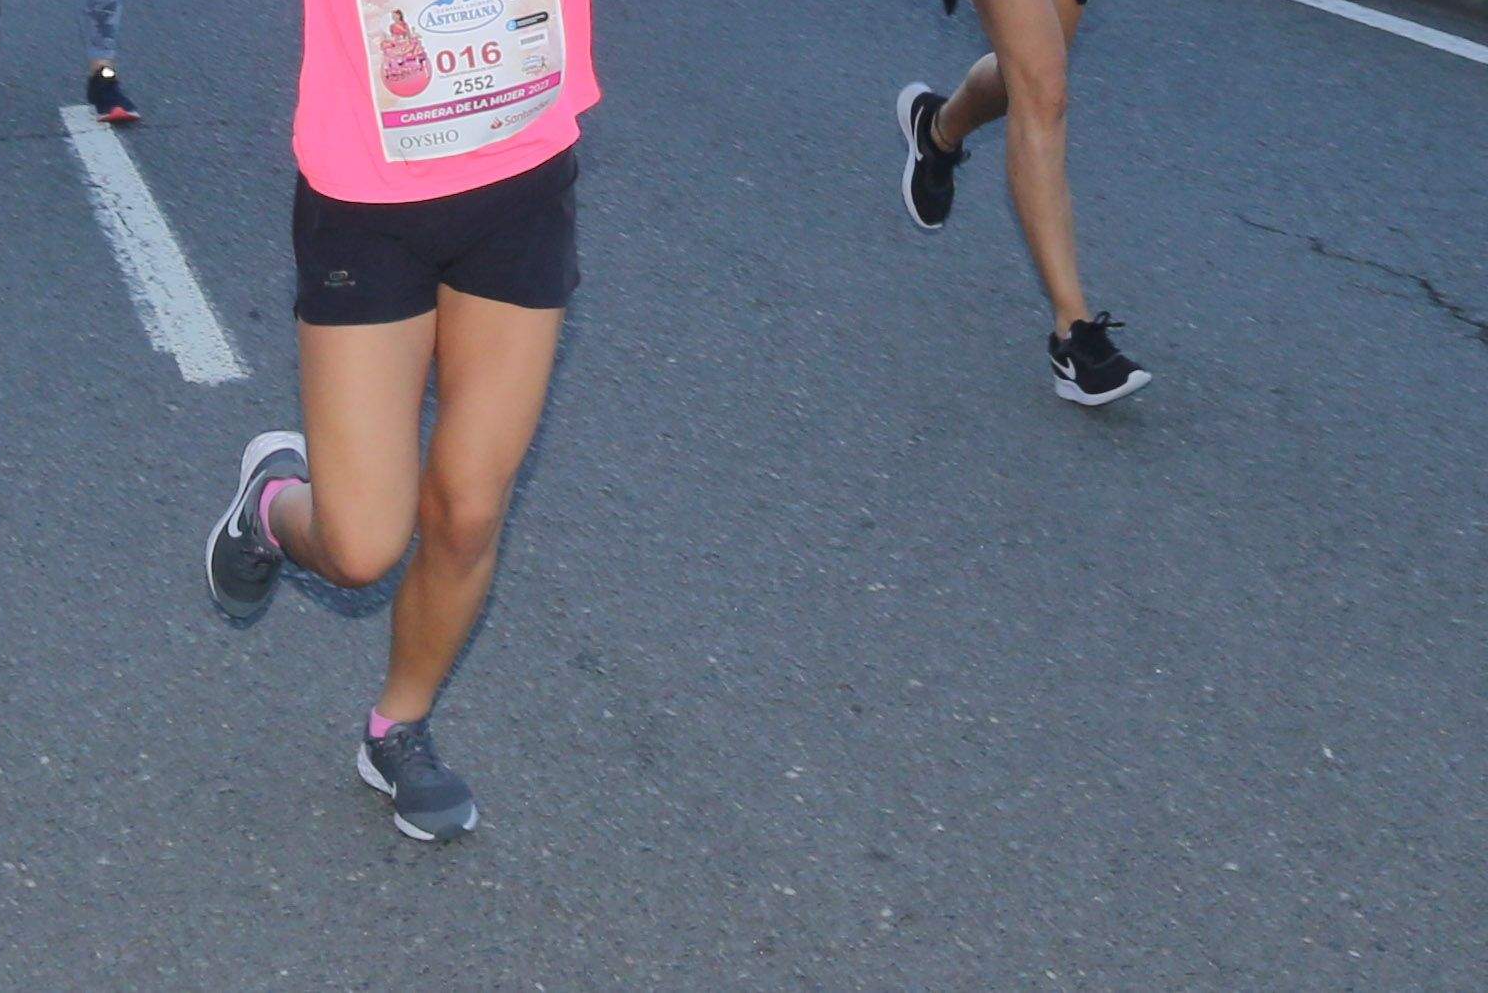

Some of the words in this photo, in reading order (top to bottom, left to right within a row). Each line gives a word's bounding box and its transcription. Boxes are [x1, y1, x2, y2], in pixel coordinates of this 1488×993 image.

[426, 4, 498, 27] ASTURIANA
[436, 41, 502, 73] 016
[453, 75, 495, 95] 2552
[400, 106, 454, 123] CARRERA
[455, 102, 473, 114] DE
[473, 98, 488, 110] LA
[489, 89, 526, 107] MUJER
[400, 129, 459, 149] OYSHO
